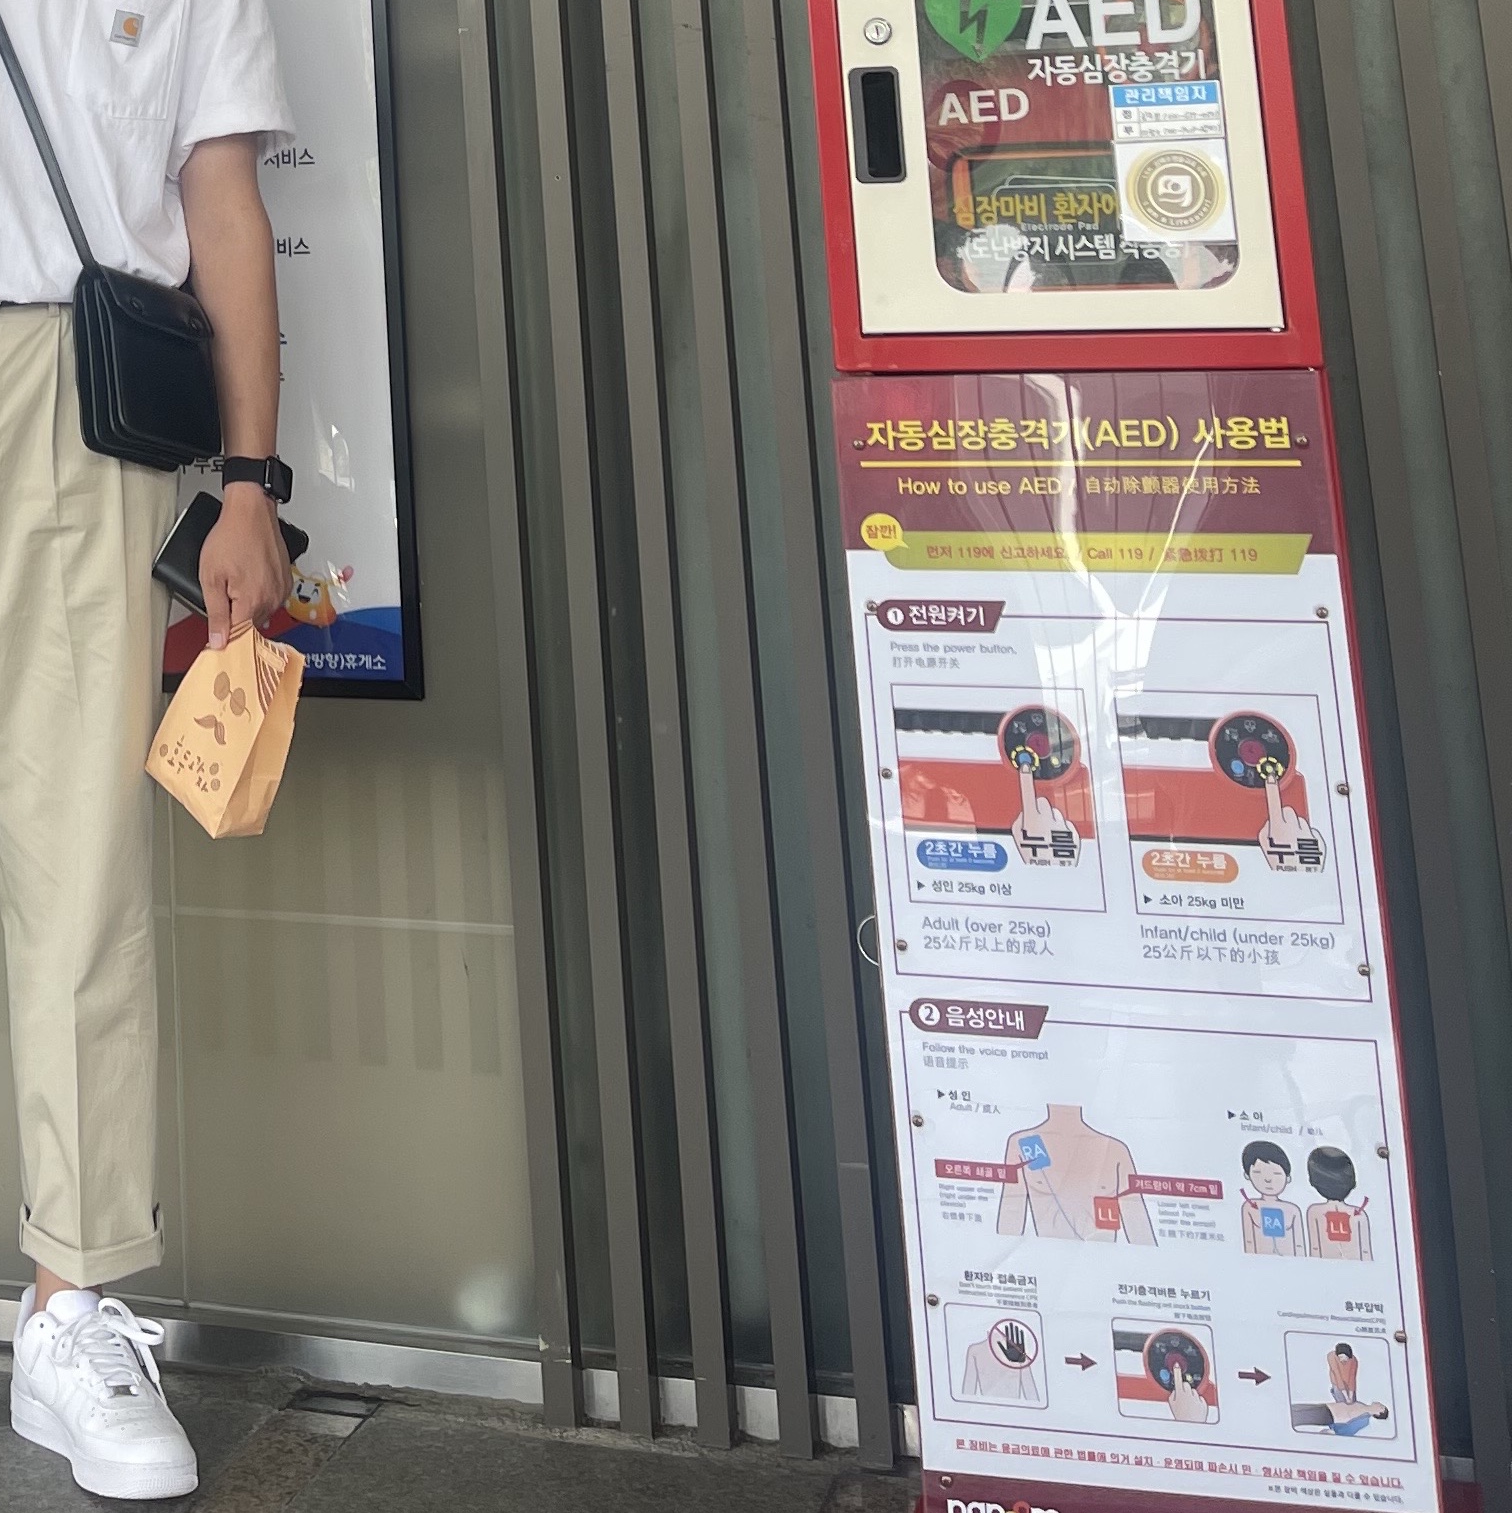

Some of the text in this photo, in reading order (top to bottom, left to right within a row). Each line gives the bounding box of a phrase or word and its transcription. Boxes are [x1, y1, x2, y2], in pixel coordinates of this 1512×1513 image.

[1026, 49, 1207, 87] 자동심장충격기
[1124, 85, 1207, 104] 관리책임자
[938, 88, 1030, 126] AED
[952, 193, 1047, 225] 심장마비
[1055, 234, 1117, 262] 시스템
[866, 415, 1292, 452] 자동심장충격기(AED) 사용법
[897, 476, 1063, 496] How to use AED
[865, 524, 897, 539] 잠깐!
[927, 545, 1065, 561] 먼저 119에 신고하세요
[1087, 547, 1144, 560] Call 119
[1230, 549, 1258, 562] 119
[908, 604, 986, 627] 전원켜기
[890, 641, 976, 655] Press the power
[925, 841, 963, 858] 2초간
[1020, 828, 1078, 859] 누름
[1266, 837, 1324, 866] 누름
[1150, 851, 1192, 869] 2초간
[931, 880, 1013, 896] 성인 25kg 이상
[1159, 894, 1245, 910] 소아 25kg 미만
[921, 916, 1052, 938] Adult (over 25kg)
[923, 935, 1055, 957] 25公斤以上的成人
[1140, 924, 1336, 950] Infant/child (under 25kg)
[1142, 944, 1281, 966] 25公斤以下的小孩
[945, 1005, 1026, 1032] 음성안내
[922, 1041, 1049, 1061] Follow the voice prompt
[1022, 1144, 1046, 1161] RA
[1098, 1207, 1118, 1222] LL
[1264, 1216, 1282, 1230] RA
[1329, 1221, 1348, 1235] LL
[1180, 1289, 1211, 1301] 누르기
[1110, 1452, 1131, 1465] 의거
